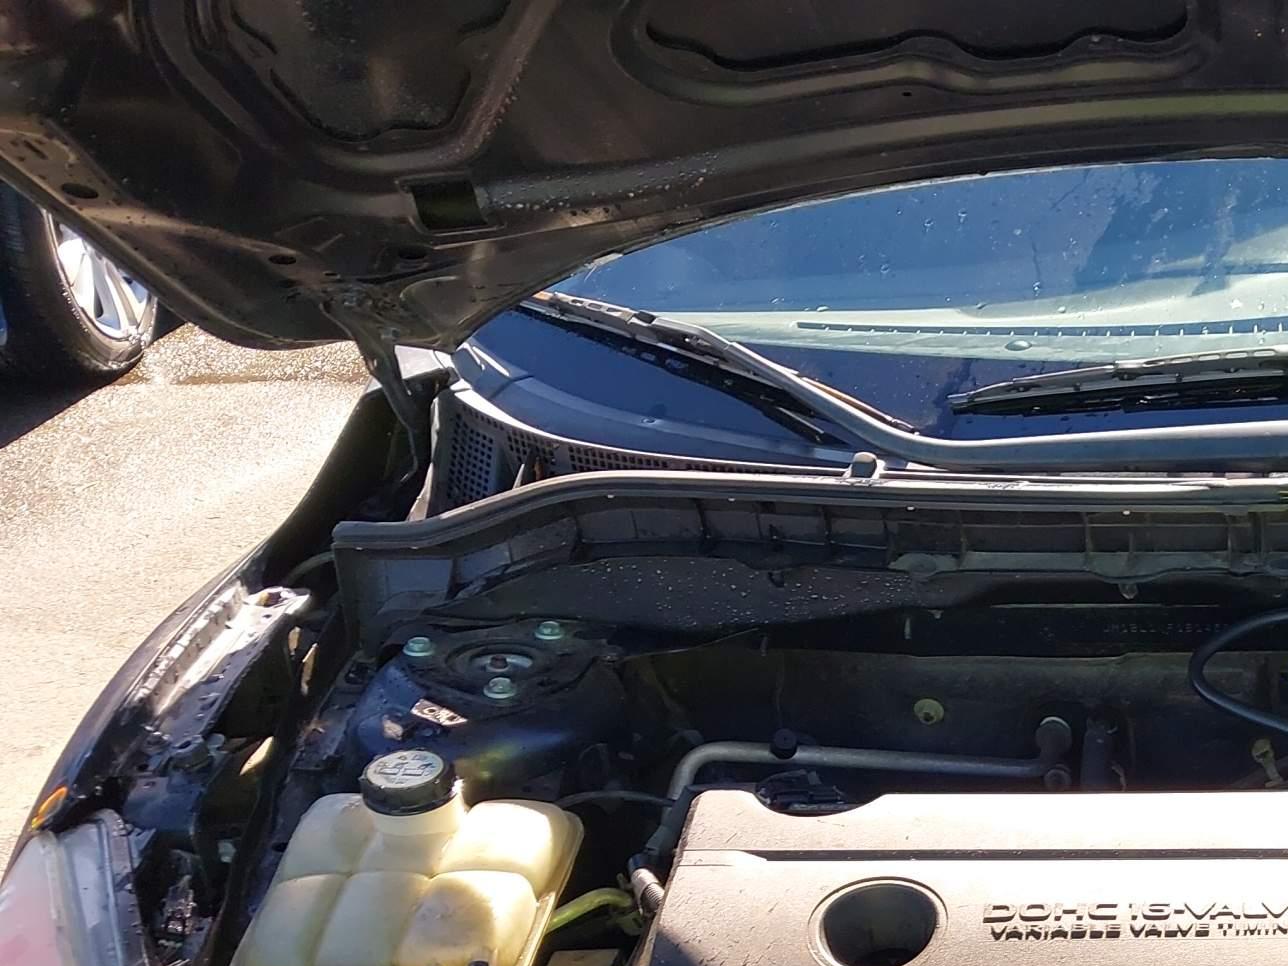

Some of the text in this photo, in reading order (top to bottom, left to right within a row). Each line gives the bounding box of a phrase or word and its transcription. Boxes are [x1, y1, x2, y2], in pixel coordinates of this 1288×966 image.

[983, 902, 1118, 924] DOHC
[991, 923, 1120, 940] VARIABLE
[1130, 922, 1210, 939] VALVE
